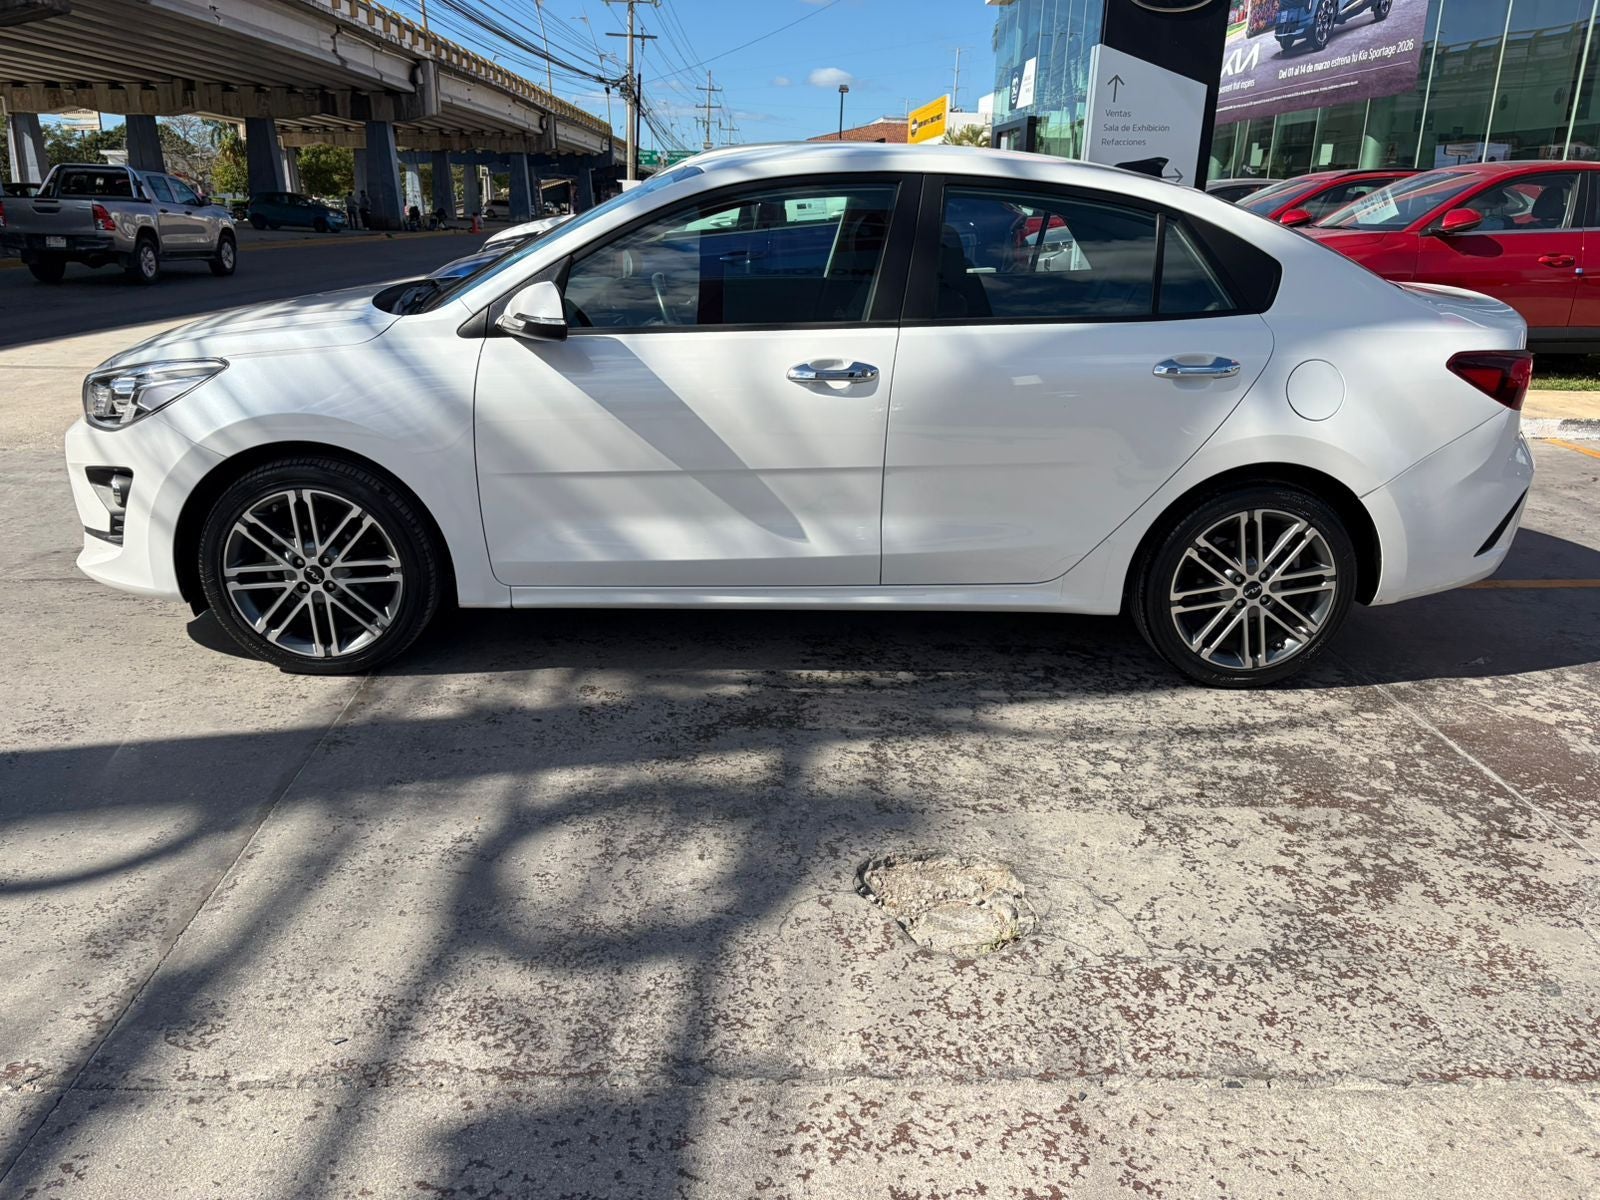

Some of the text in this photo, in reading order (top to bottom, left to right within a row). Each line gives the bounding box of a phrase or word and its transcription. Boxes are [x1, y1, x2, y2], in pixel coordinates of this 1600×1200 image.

[1278, 68, 1288, 79] Del
[1288, 66, 1294, 77] 01
[1294, 65, 1300, 76] al
[1306, 62, 1314, 73] de
[1314, 60, 1331, 72] marzo
[1330, 55, 1351, 67] estrena
[1352, 52, 1358, 63] tu
[1358, 49, 1368, 61] Kia
[1368, 44, 1397, 61] Sportage
[1397, 39, 1414, 53] 2026
[1105, 109, 1132, 118] Ventas
[1103, 123, 1170, 132] Sala de Exhibición
[1101, 138, 1147, 147] Refacciones
